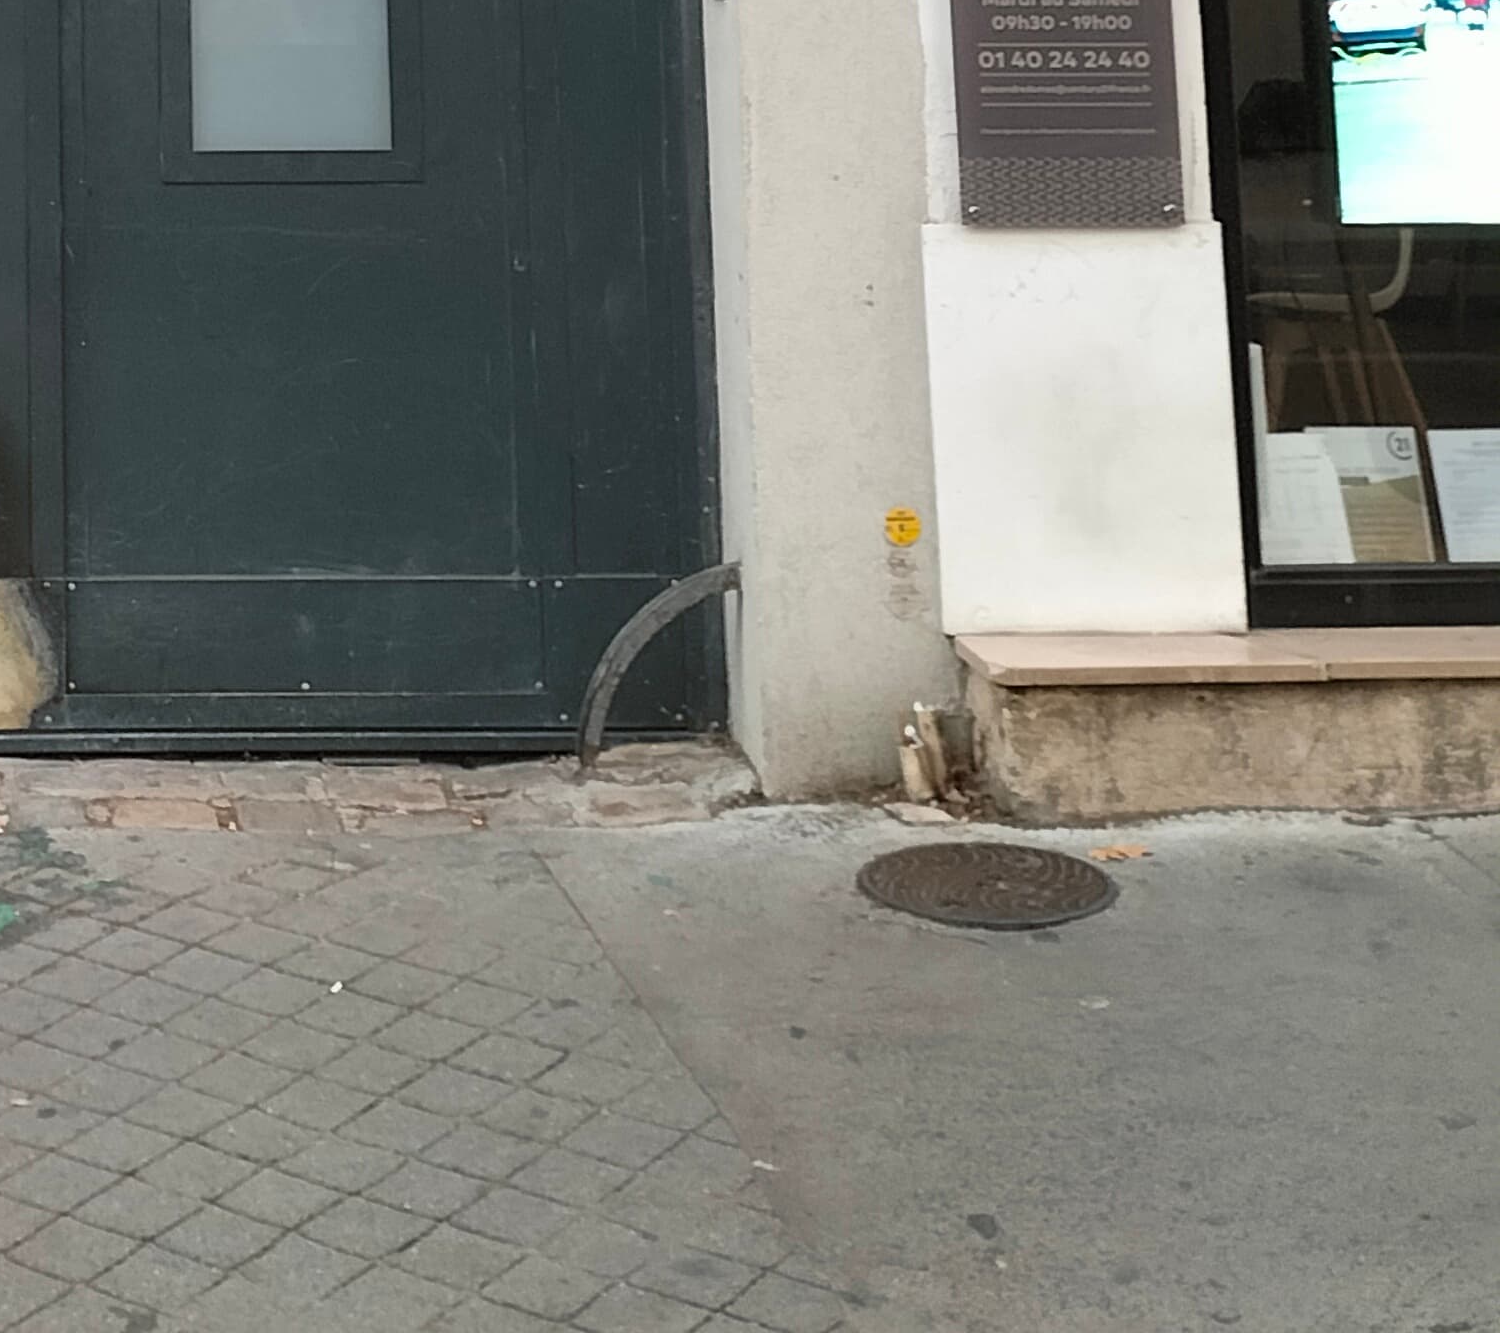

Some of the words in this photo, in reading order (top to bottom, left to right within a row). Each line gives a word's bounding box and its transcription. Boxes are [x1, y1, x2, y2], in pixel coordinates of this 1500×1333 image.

[991, 15, 1055, 31] 09h30
[1071, 15, 1132, 31] 19h00
[978, 51, 1005, 69] 01
[1010, 51, 1043, 68] 40
[1049, 51, 1078, 68] 24
[1083, 51, 1112, 68] 24
[1117, 51, 1150, 68] 40
